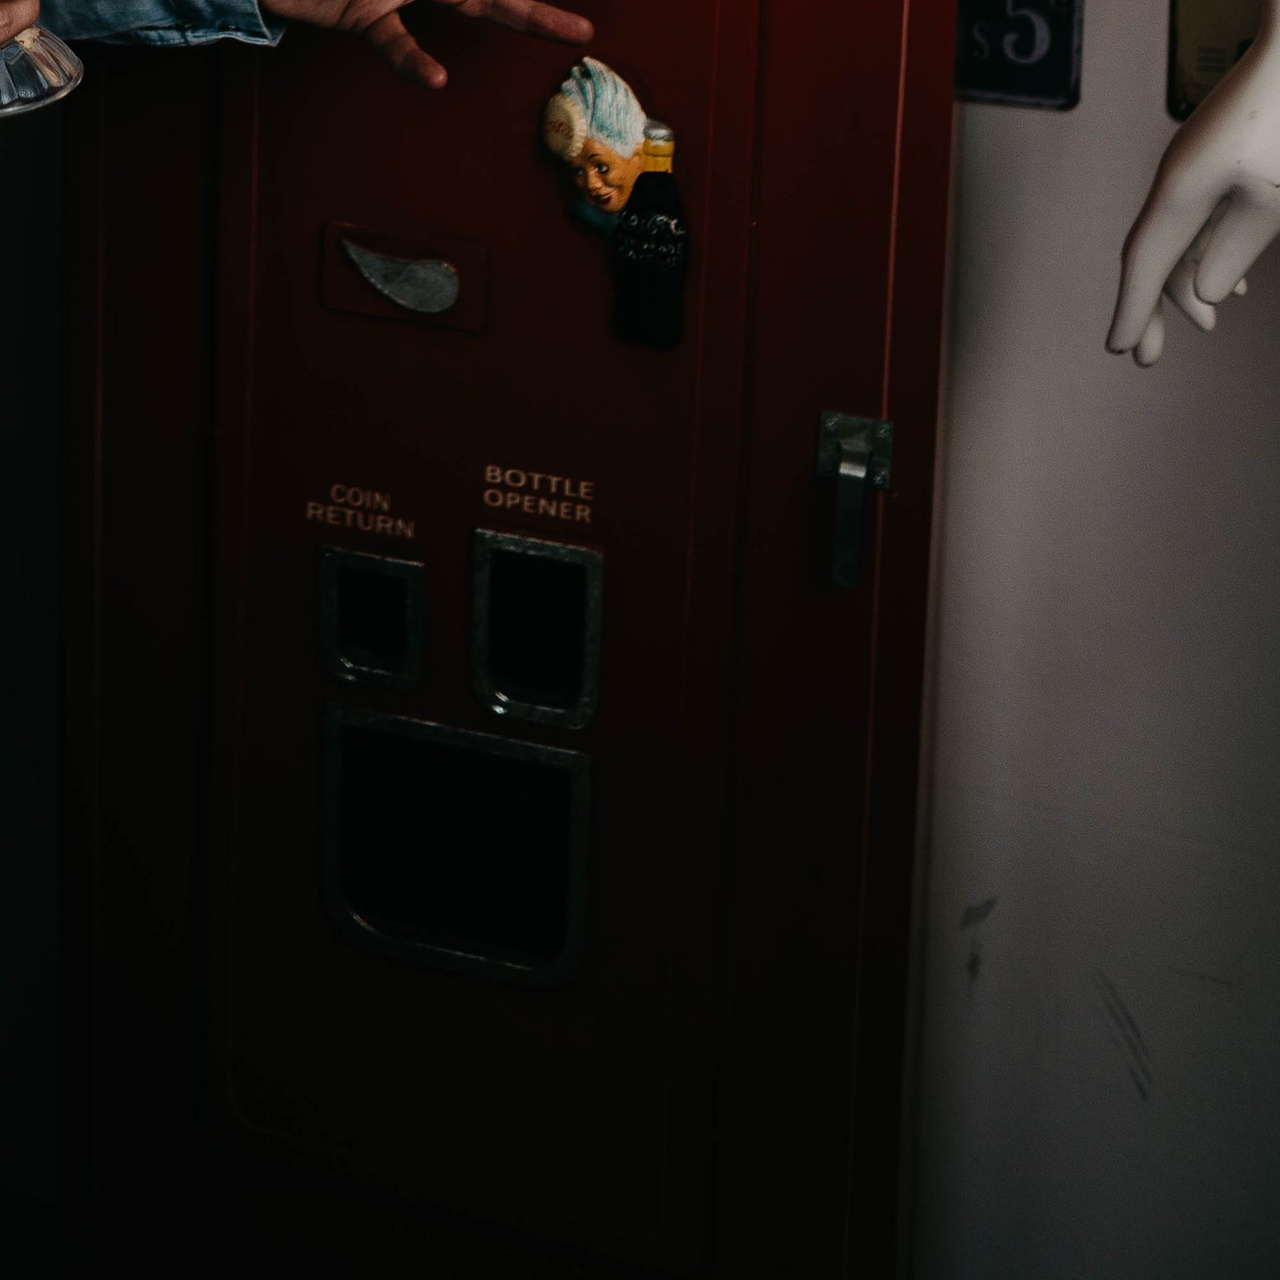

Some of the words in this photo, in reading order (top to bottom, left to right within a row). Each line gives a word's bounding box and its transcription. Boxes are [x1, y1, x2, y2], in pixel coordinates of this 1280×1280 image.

[329, 483, 391, 513] COIN
[483, 463, 596, 501] BOTTLE
[305, 500, 416, 539] RETURN
[482, 488, 594, 525] OPENER
